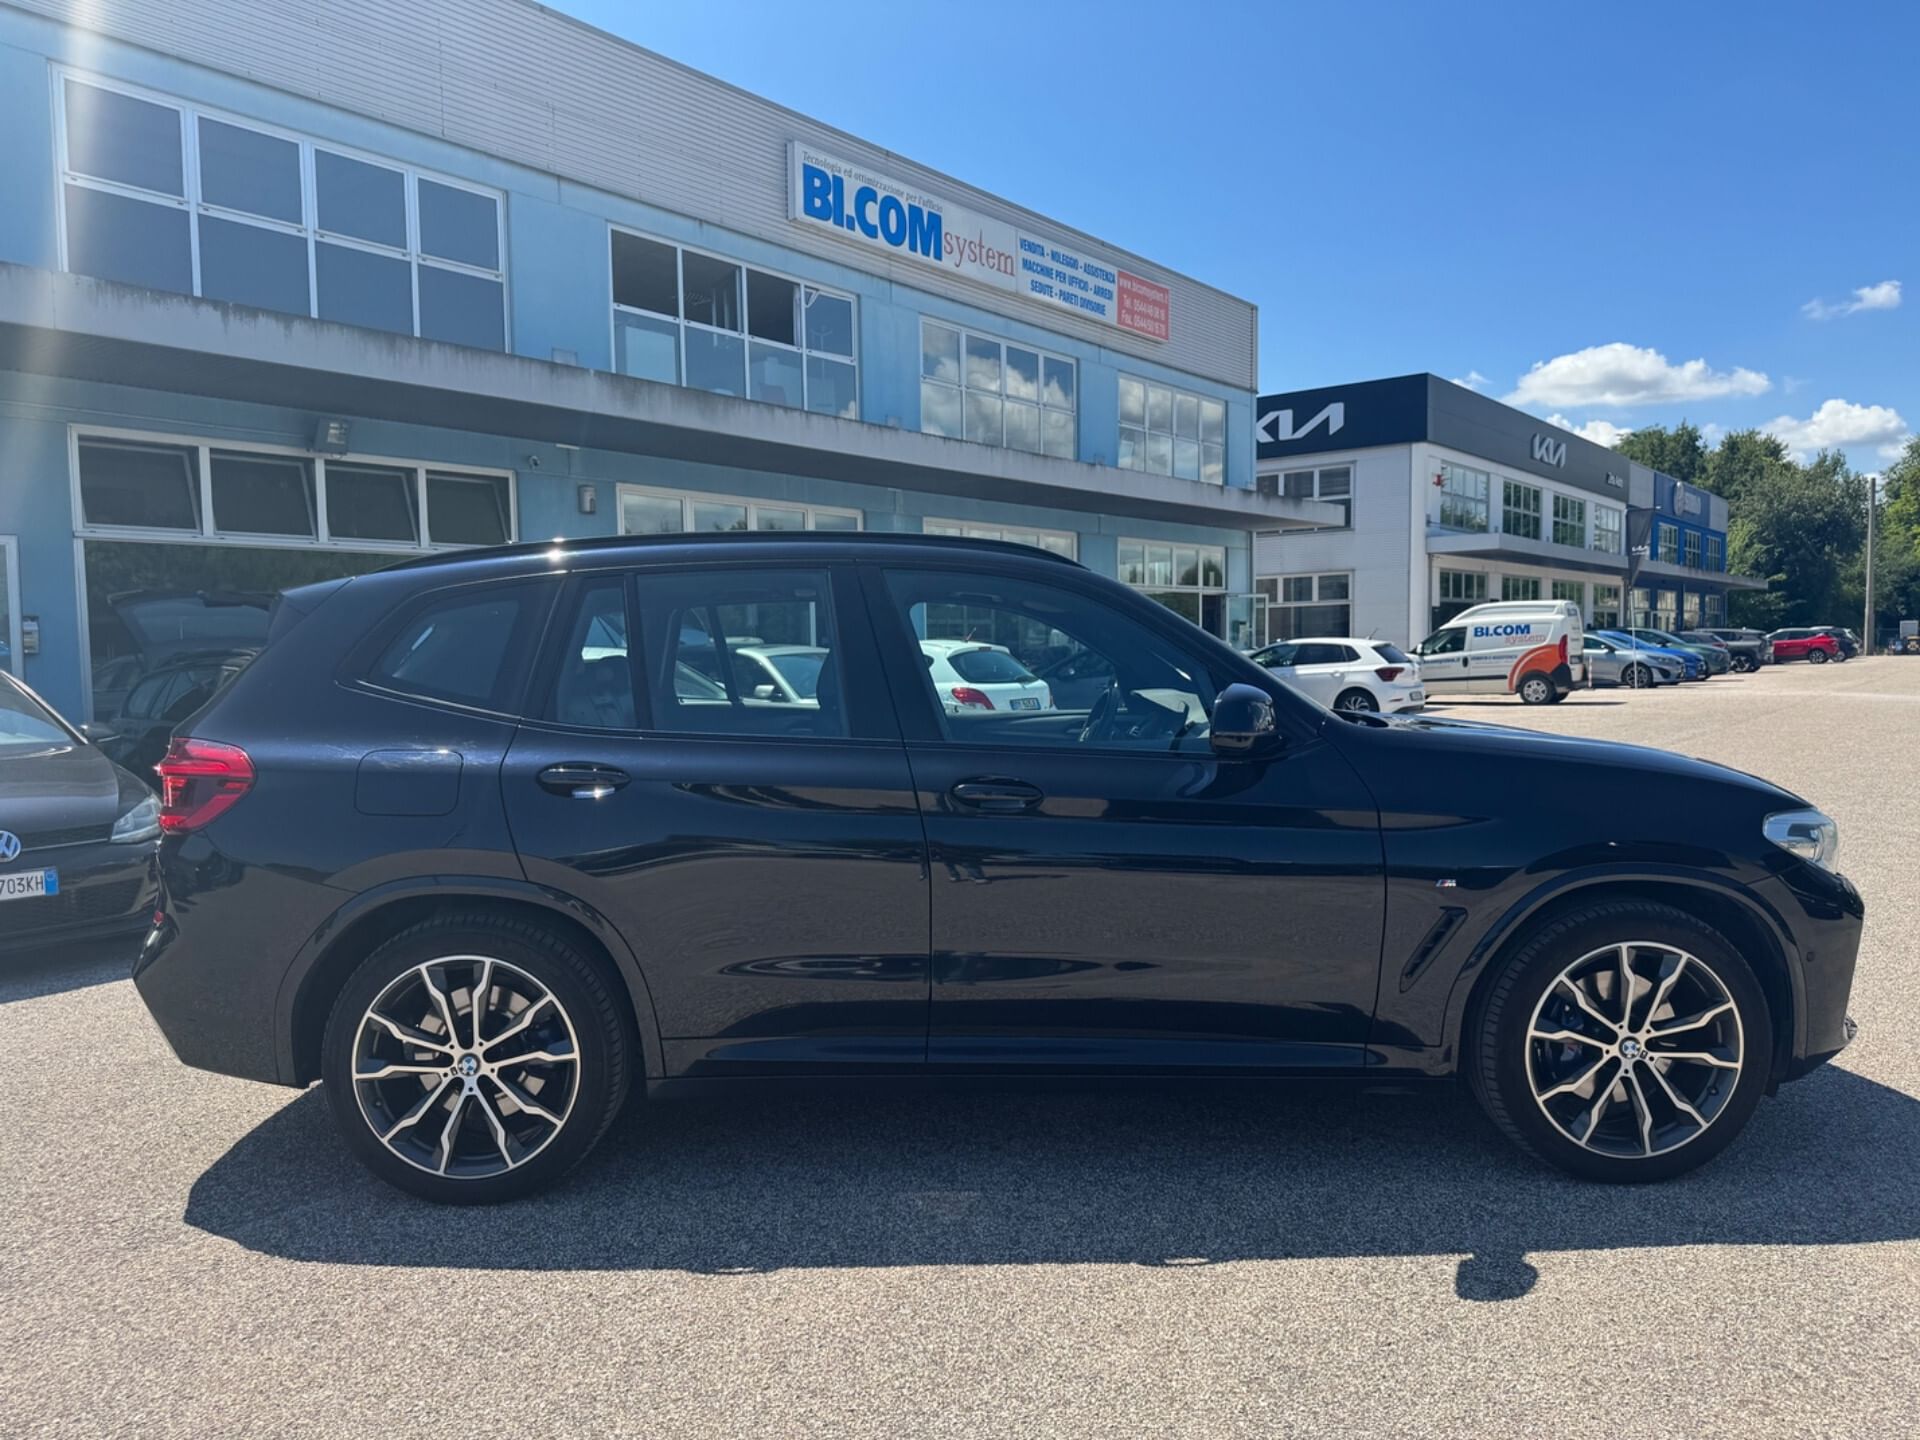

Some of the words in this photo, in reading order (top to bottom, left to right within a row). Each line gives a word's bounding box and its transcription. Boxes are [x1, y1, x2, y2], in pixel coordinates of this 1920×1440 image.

[802, 151, 842, 174] Tecnologia
[843, 167, 852, 178] ed
[854, 173, 905, 197] ottimizzazione
[905, 191, 918, 203] per
[803, 163, 943, 262] BI.COM
[944, 229, 1015, 277] system
[1019, 238, 1045, 257] VENDITA
[1051, 249, 1079, 270] NOLEGGIO
[1084, 262, 1116, 284] ASSISTENZA
[1022, 257, 1054, 280] MACCHINE
[1055, 269, 1067, 283] PER
[1068, 274, 1089, 292] UFFICIO
[1094, 284, 1113, 301] ARREDI
[1030, 279, 1054, 298] SEDUTE
[1059, 289, 1079, 307] PARETI
[1080, 297, 1106, 316] DIVISORIE
[1533, 433, 1567, 469] KIA
[1474, 624, 1531, 638] BI.COM
[1505, 634, 1546, 645] system
